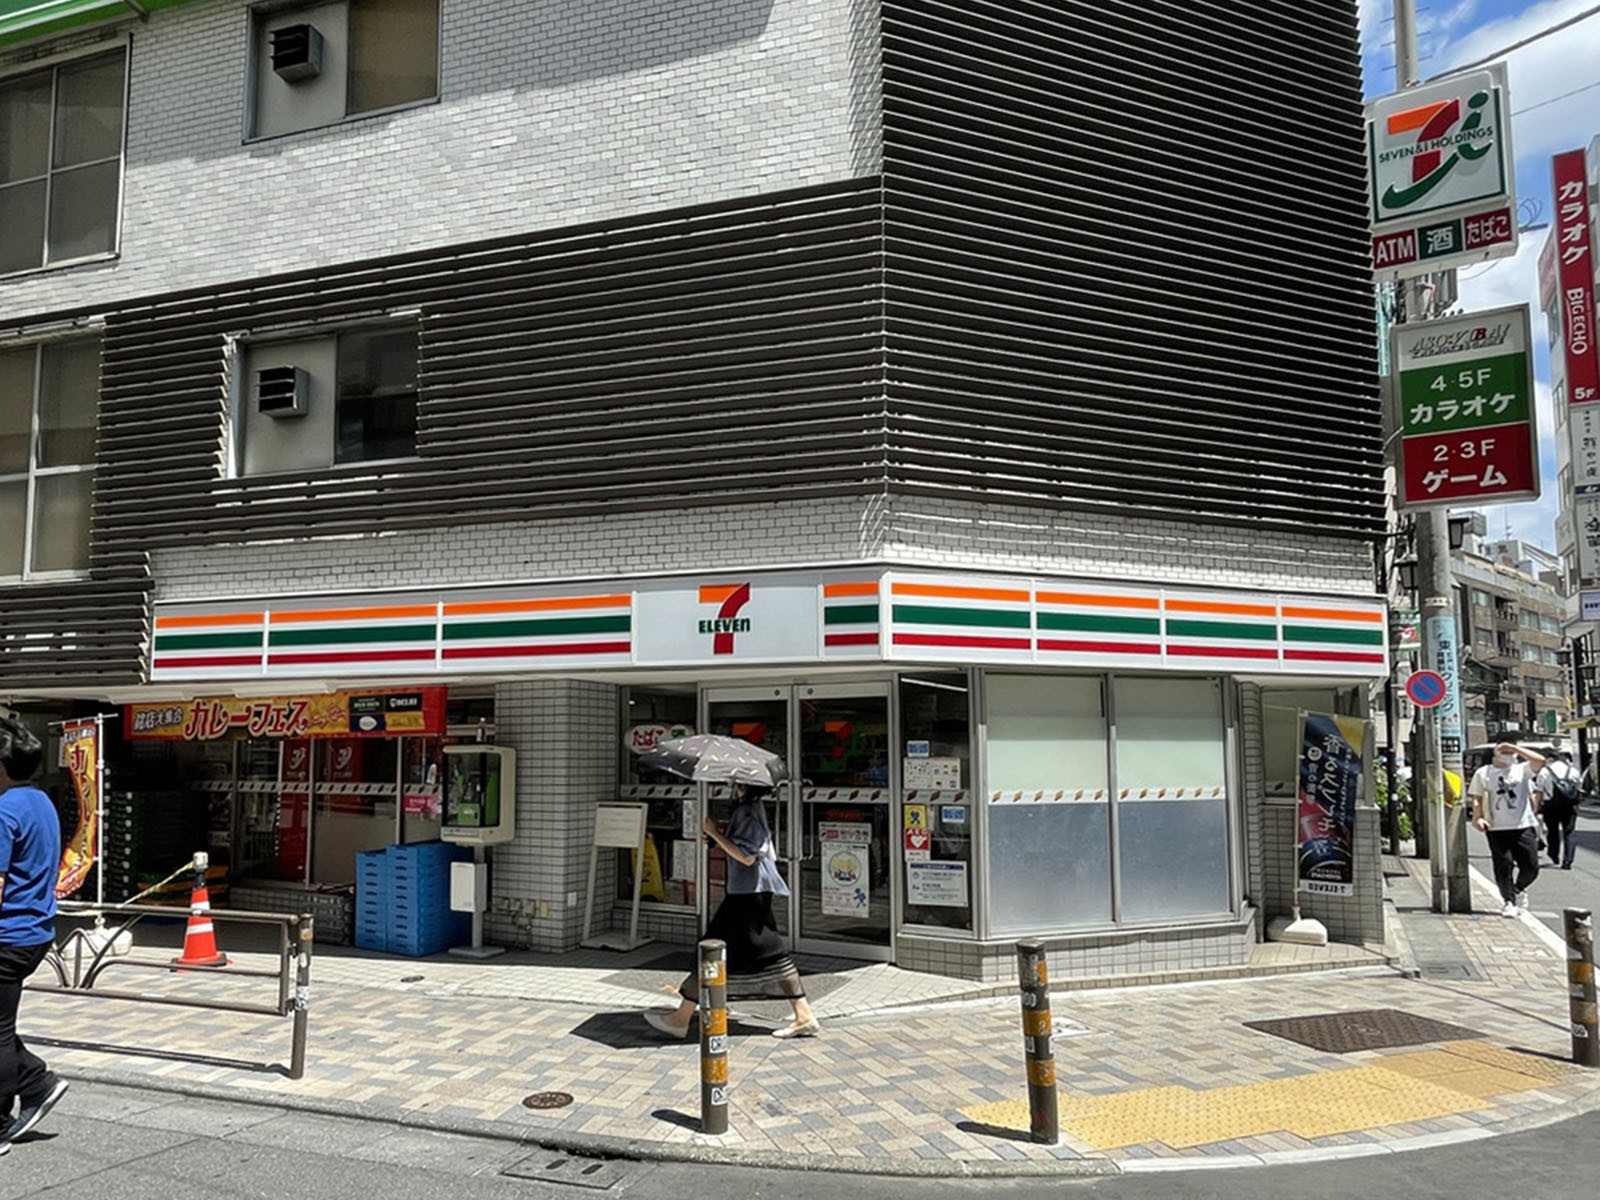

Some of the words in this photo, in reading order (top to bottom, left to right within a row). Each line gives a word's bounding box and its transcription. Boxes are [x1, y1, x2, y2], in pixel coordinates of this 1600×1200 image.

[1431, 126, 1494, 150] HOLDINGS
[1465, 215, 1510, 245] たばこ
[1559, 180, 1588, 265] カラオケ
[1376, 235, 1414, 264] ATM
[1425, 224, 1455, 255] 酒
[1409, 392, 1516, 425] カラオケ
[1574, 387, 1595, 400] 5F
[1422, 464, 1508, 493] ゲーム
[184, 699, 309, 740] カレーフェス
